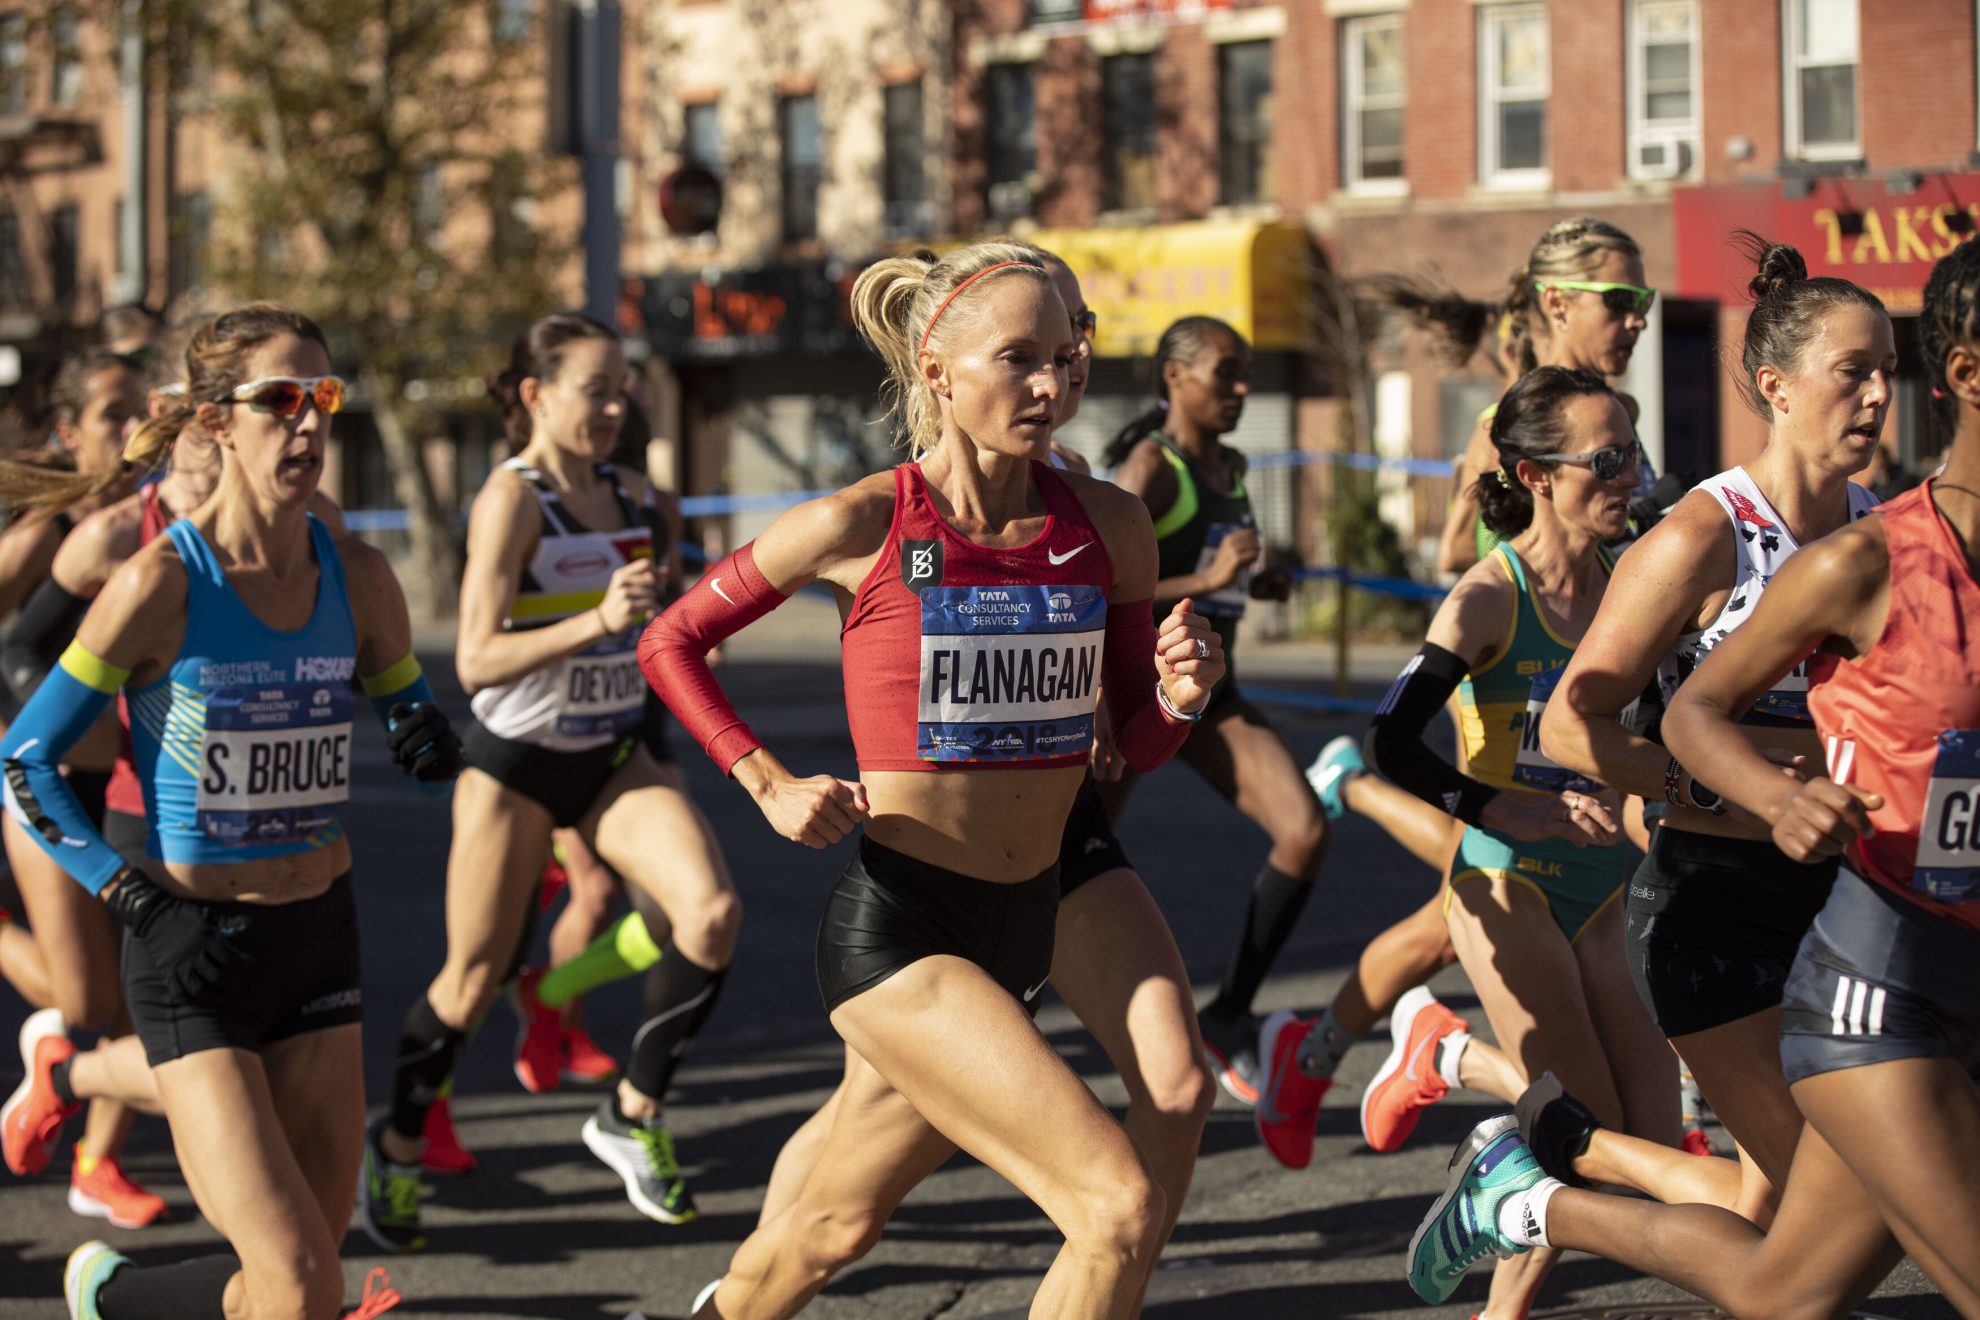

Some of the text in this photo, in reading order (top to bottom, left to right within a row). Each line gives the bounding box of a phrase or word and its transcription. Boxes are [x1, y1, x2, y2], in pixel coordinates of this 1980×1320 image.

[1813, 202, 1980, 265] TAKS
[978, 591, 1010, 601] TATA
[958, 603, 1031, 614] CONSULTANCY
[972, 615, 1019, 626] SERVICES
[1046, 612, 1076, 623] TATA
[931, 645, 1096, 704] FLANAGAN
[203, 734, 347, 795] S. BRUCE
[1517, 856, 1563, 877] BLK
